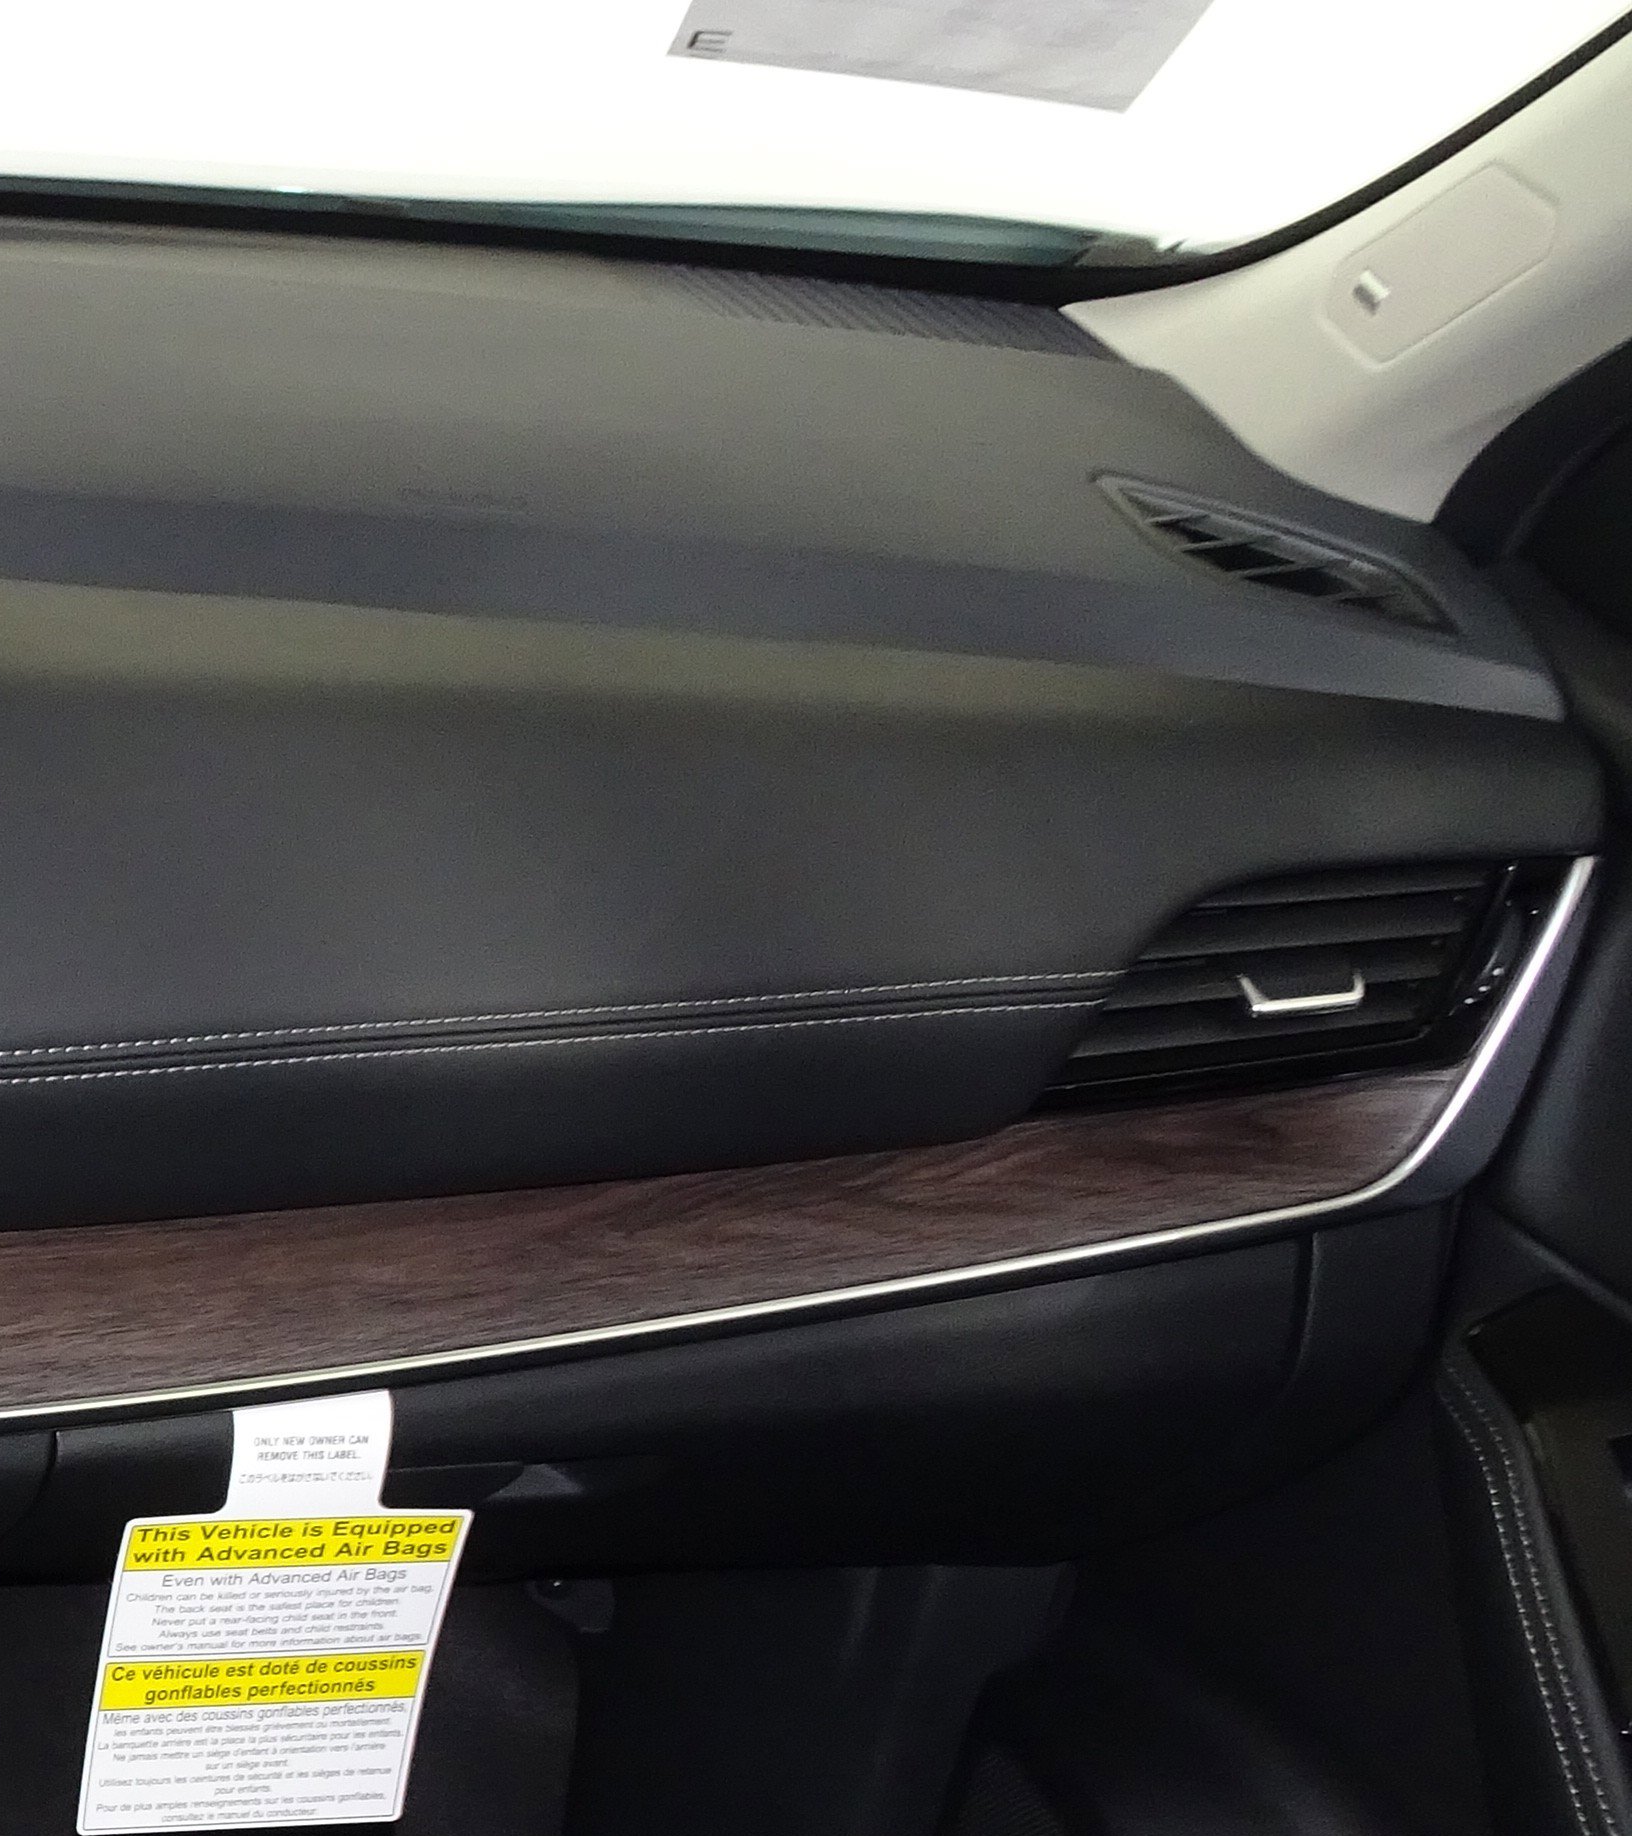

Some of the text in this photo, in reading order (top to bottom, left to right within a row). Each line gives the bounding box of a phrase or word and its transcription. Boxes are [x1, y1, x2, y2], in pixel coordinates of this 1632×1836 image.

[254, 1436, 369, 1446] ONLY NEW OWNER CAN
[257, 1451, 298, 1460] REMOVE
[303, 1451, 324, 1460] THIS
[138, 1520, 456, 1542] This Vehicle is Equipped
[134, 1541, 447, 1563] with Advanced Air Bags
[162, 1568, 407, 1587] Even with Advanced Air Bags
[127, 1593, 172, 1602] Children
[176, 1593, 196, 1601] can
[200, 1592, 214, 1601] be
[218, 1591, 246, 1600] killed
[250, 1591, 261, 1599] or
[264, 1588, 312, 1599] seriously
[356, 1587, 369, 1596] by
[373, 1586, 390, 1594] the
[393, 1585, 407, 1593] air
[155, 1605, 175, 1614] The
[180, 1604, 204, 1613] back
[210, 1604, 232, 1613] seat
[248, 1603, 265, 1611] the
[304, 1600, 335, 1610] place
[339, 1599, 352, 1608] for
[152, 1618, 185, 1626] Never
[188, 1617, 205, 1627] put
[220, 1615, 279, 1625] rear-facing
[282, 1613, 307, 1622] child
[311, 1612, 334, 1621] seat
[337, 1612, 347, 1620] in
[351, 1610, 368, 1619] the
[158, 1630, 198, 1639] Always
[225, 1628, 247, 1636] seat
[251, 1627, 277, 1636] belts
[280, 1626, 301, 1634] and
[304, 1625, 331, 1634] child
[115, 1643, 137, 1652] See
[187, 1641, 227, 1650] manual
[231, 1640, 246, 1648] for
[248, 1640, 277, 1648] more
[280, 1635, 341, 1646] information
[344, 1634, 375, 1643] about
[378, 1633, 391, 1641] air
[111, 1656, 417, 1681] Ce véhicule est doté de coussins
[144, 1678, 375, 1705] gonflables perfectionnés
[144, 1713, 173, 1723] avec
[176, 1711, 198, 1722] des
[201, 1708, 253, 1721] coussins
[257, 1705, 319, 1721] gonflables
